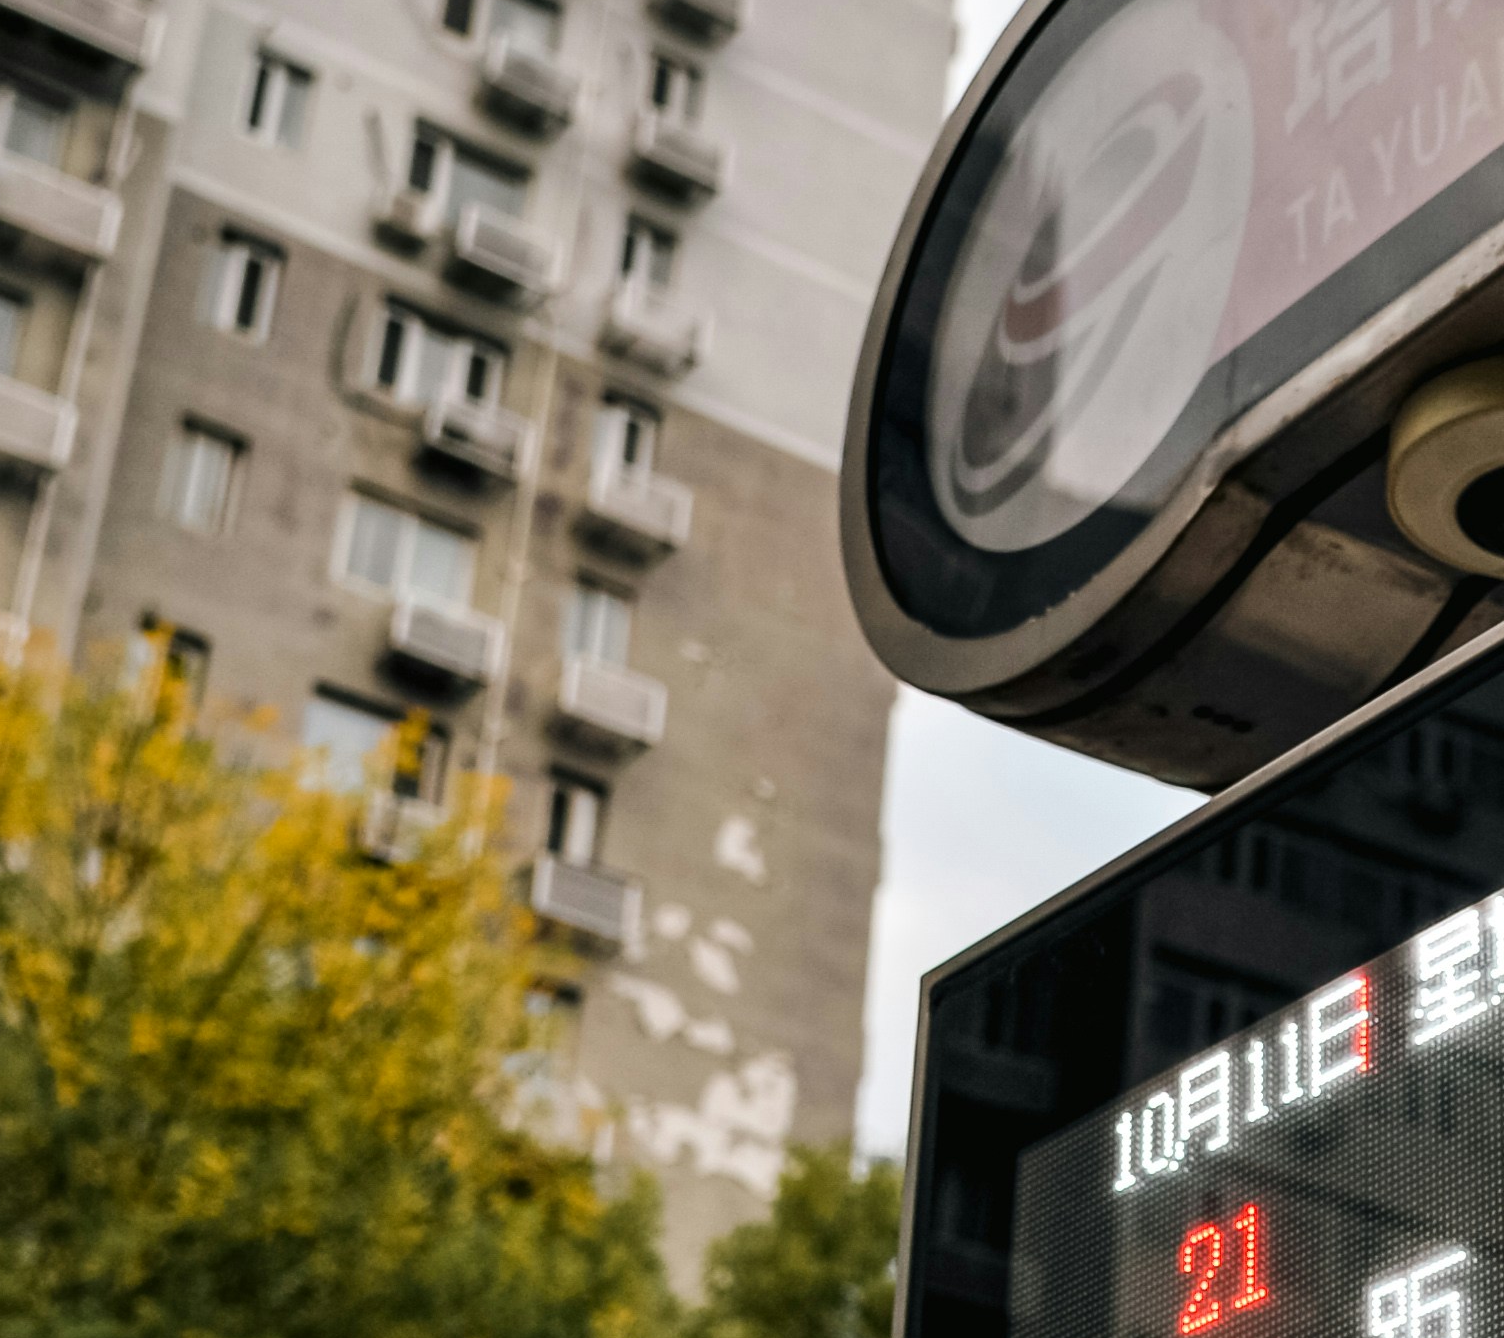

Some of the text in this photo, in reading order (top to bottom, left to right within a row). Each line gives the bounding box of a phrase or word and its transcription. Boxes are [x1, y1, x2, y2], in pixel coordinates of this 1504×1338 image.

[1286, 169, 1357, 263] TA
[1113, 973, 1372, 1192] 10月11日
[1178, 1202, 1269, 1336] 21
